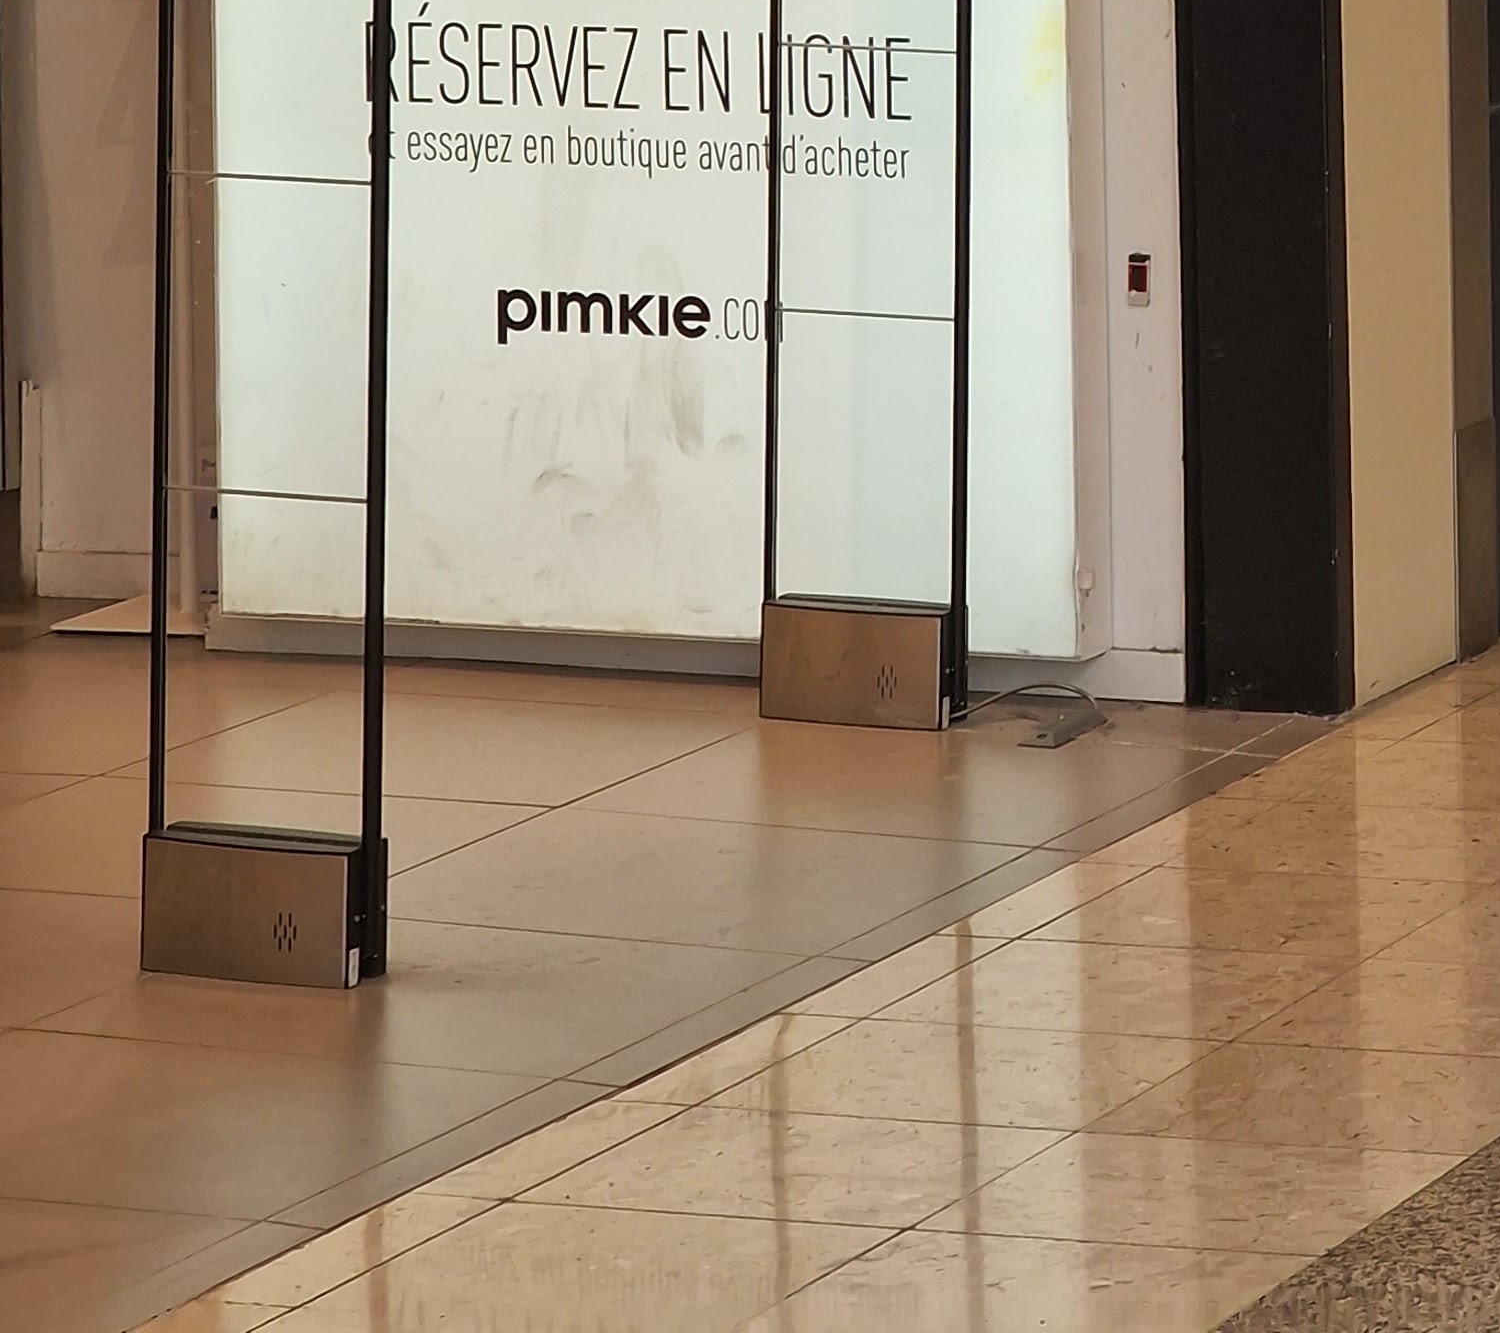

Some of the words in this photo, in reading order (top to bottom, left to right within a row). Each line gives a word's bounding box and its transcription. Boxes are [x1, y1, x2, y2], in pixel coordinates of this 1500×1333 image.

[663, 29, 731, 113] EN
[407, 131, 513, 174] essayez
[523, 133, 555, 165] en
[567, 124, 687, 180] boutique
